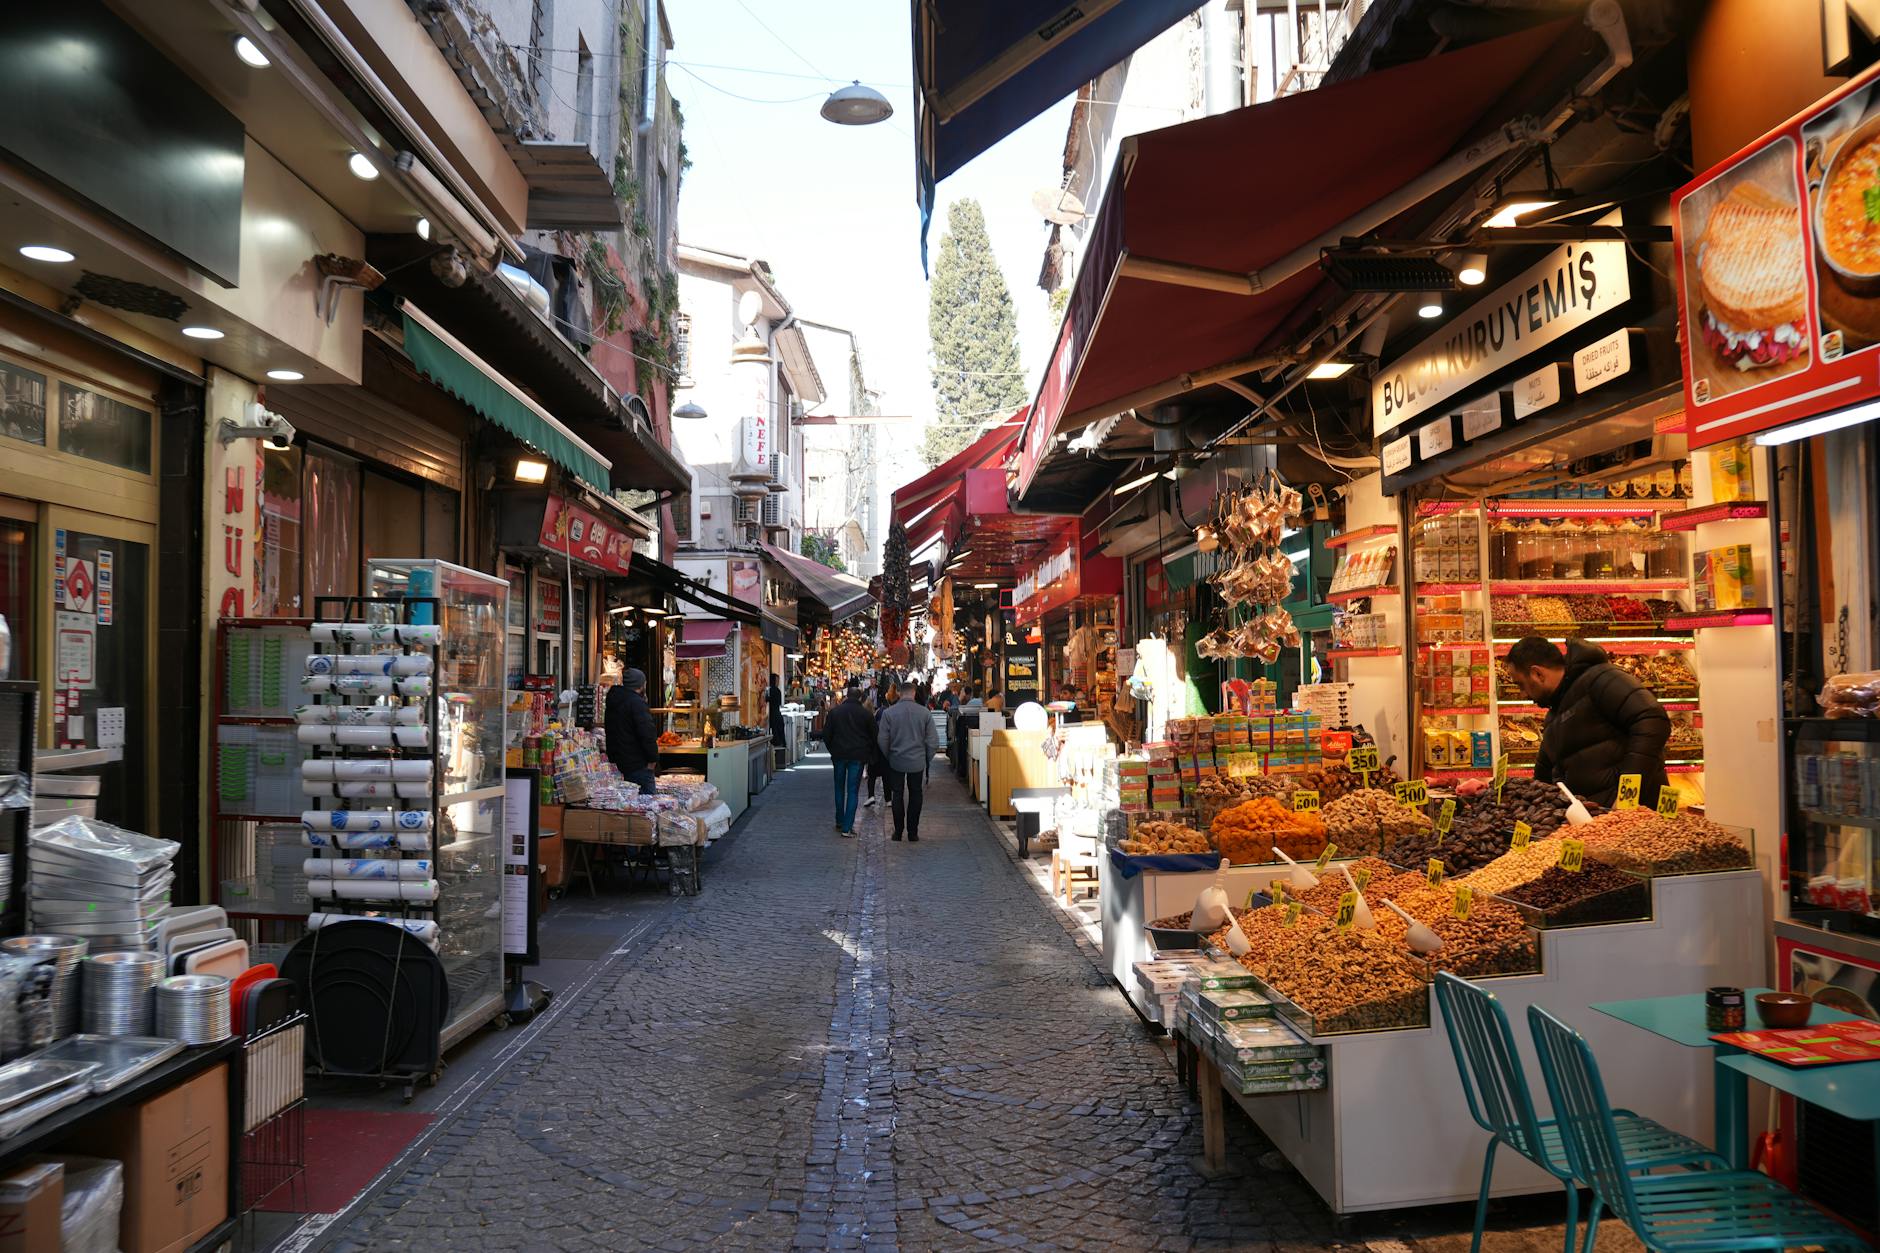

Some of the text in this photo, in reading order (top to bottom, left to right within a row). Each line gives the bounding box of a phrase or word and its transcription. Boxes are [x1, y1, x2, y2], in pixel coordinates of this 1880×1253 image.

[1446, 245, 1597, 377] KURUYEMİŞ
[1582, 339, 1619, 366] DRIED FRUITS
[1352, 753, 1377, 770] 350
[1398, 786, 1426, 804] 700
[1619, 784, 1638, 801] 900
[1295, 797, 1318, 810] 600
[1658, 796, 1677, 814] 900
